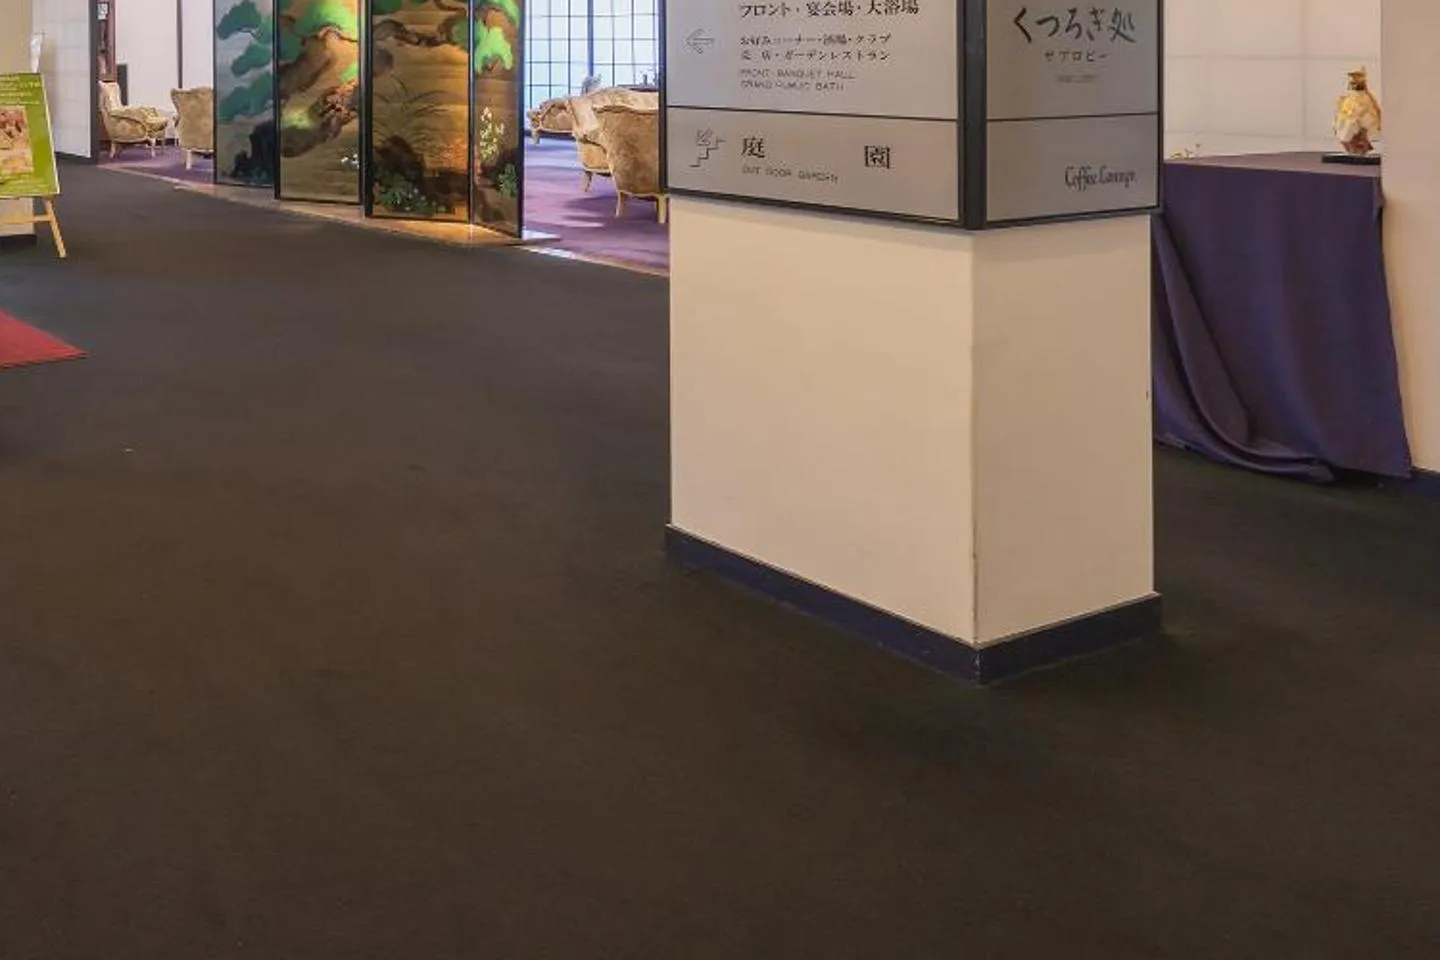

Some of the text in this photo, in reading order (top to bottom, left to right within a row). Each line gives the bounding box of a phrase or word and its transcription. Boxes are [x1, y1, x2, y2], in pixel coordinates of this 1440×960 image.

[1013, 6, 1137, 44] くつろぎ処
